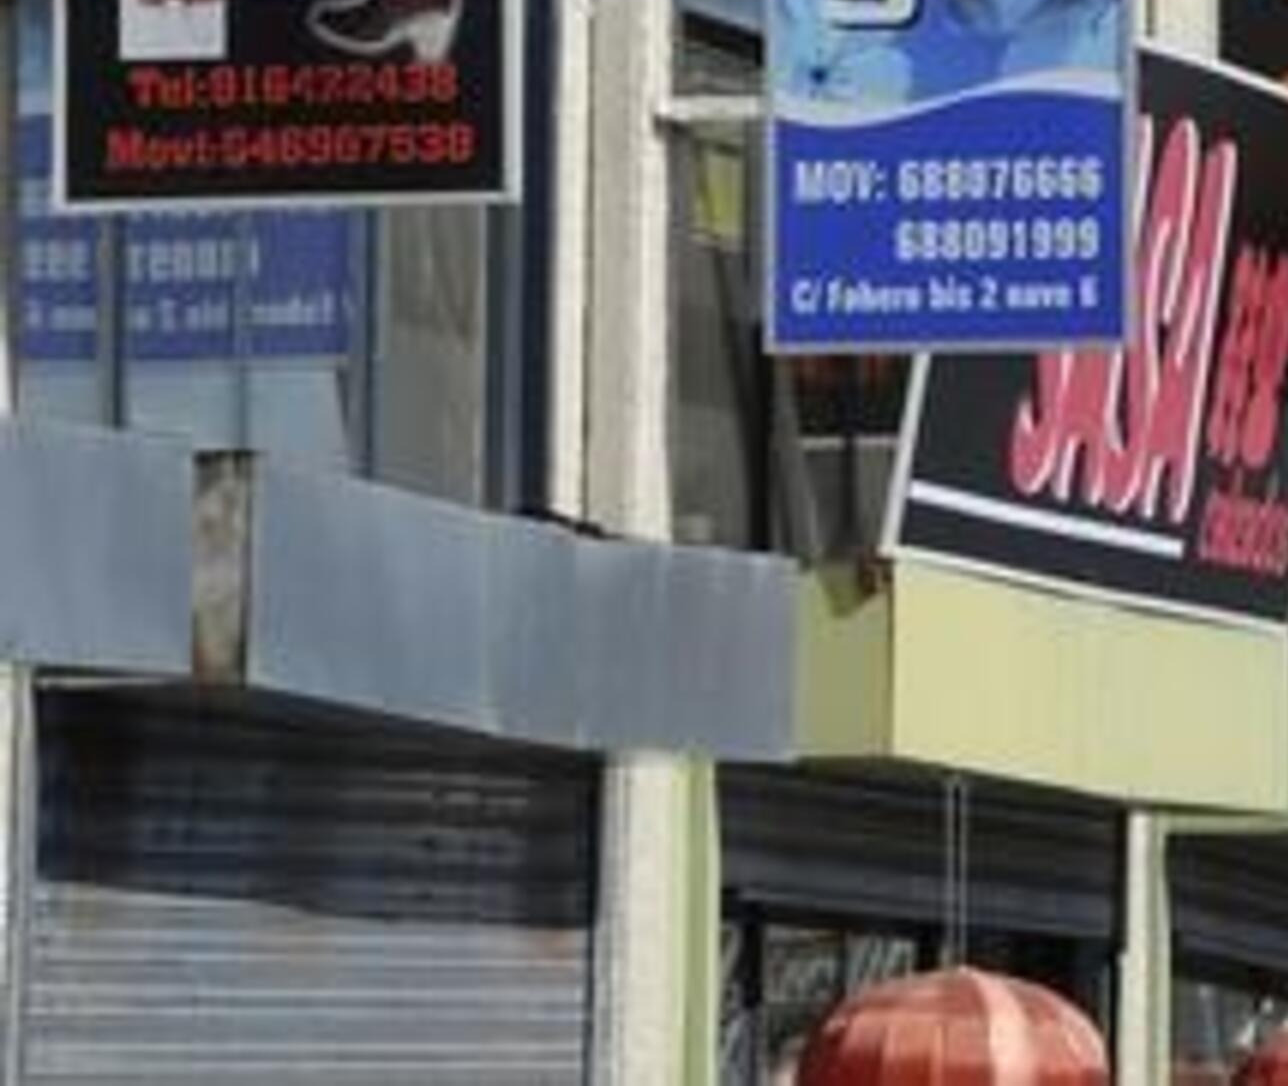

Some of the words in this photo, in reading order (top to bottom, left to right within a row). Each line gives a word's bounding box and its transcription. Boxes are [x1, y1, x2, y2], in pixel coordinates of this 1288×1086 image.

[792, 159, 887, 203] MOV:
[928, 273, 974, 311] bis
[979, 274, 1000, 310] 2
[1005, 284, 1073, 309] nave
